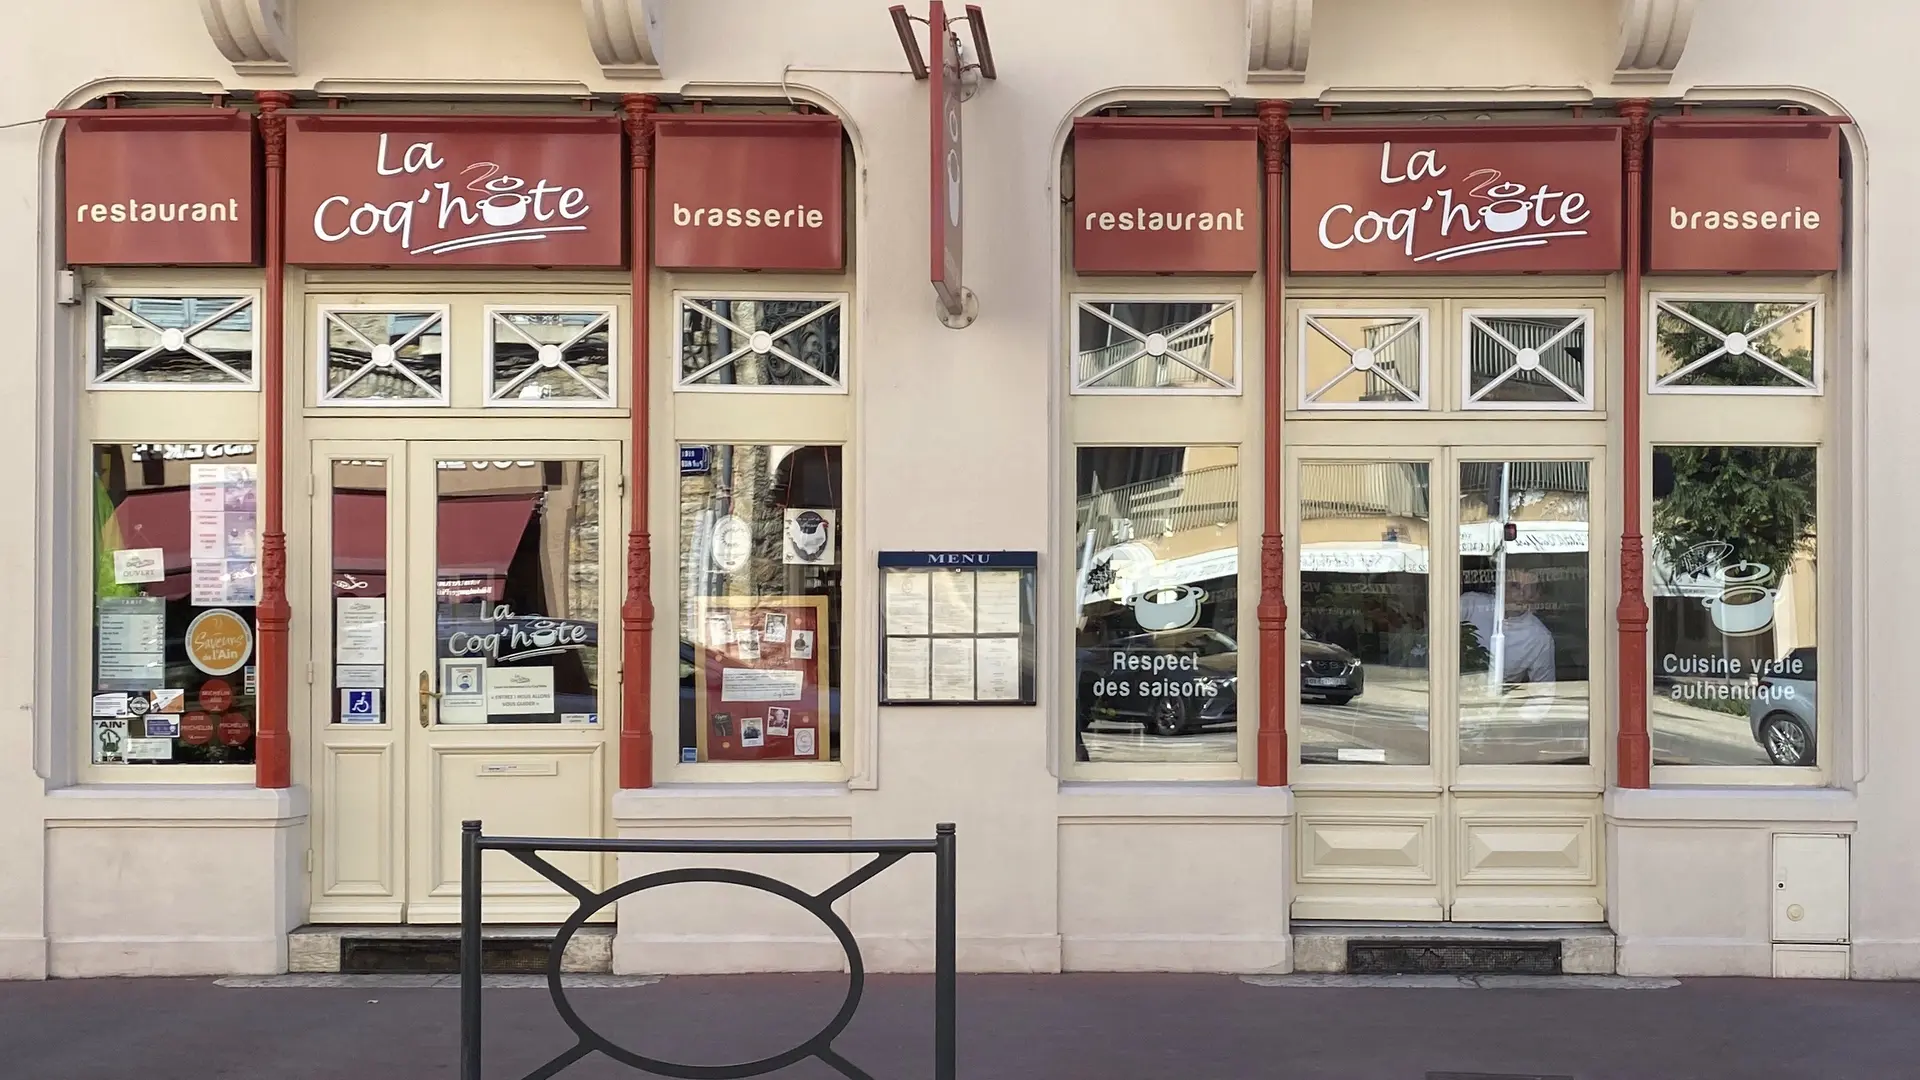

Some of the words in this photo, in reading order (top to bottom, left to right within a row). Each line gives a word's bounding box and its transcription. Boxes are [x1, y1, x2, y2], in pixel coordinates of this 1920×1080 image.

[376, 133, 444, 176] La
[1380, 141, 1447, 184] La
[77, 198, 239, 223] restaurant
[673, 202, 823, 228] brasserie
[1086, 207, 1245, 231] restaurant
[1670, 206, 1820, 230] brasserie
[927, 553, 991, 564] MENU
[480, 600, 515, 621] La
[212, 648, 238, 660] l'Ain
[1113, 651, 1199, 675] Respect
[1663, 653, 1741, 674] Cuisine
[1751, 655, 1804, 675] vraie
[1093, 678, 1130, 697] des
[1139, 678, 1218, 697] saisons
[1671, 681, 1796, 704] authentique
[99, 721, 122, 729] AIN
